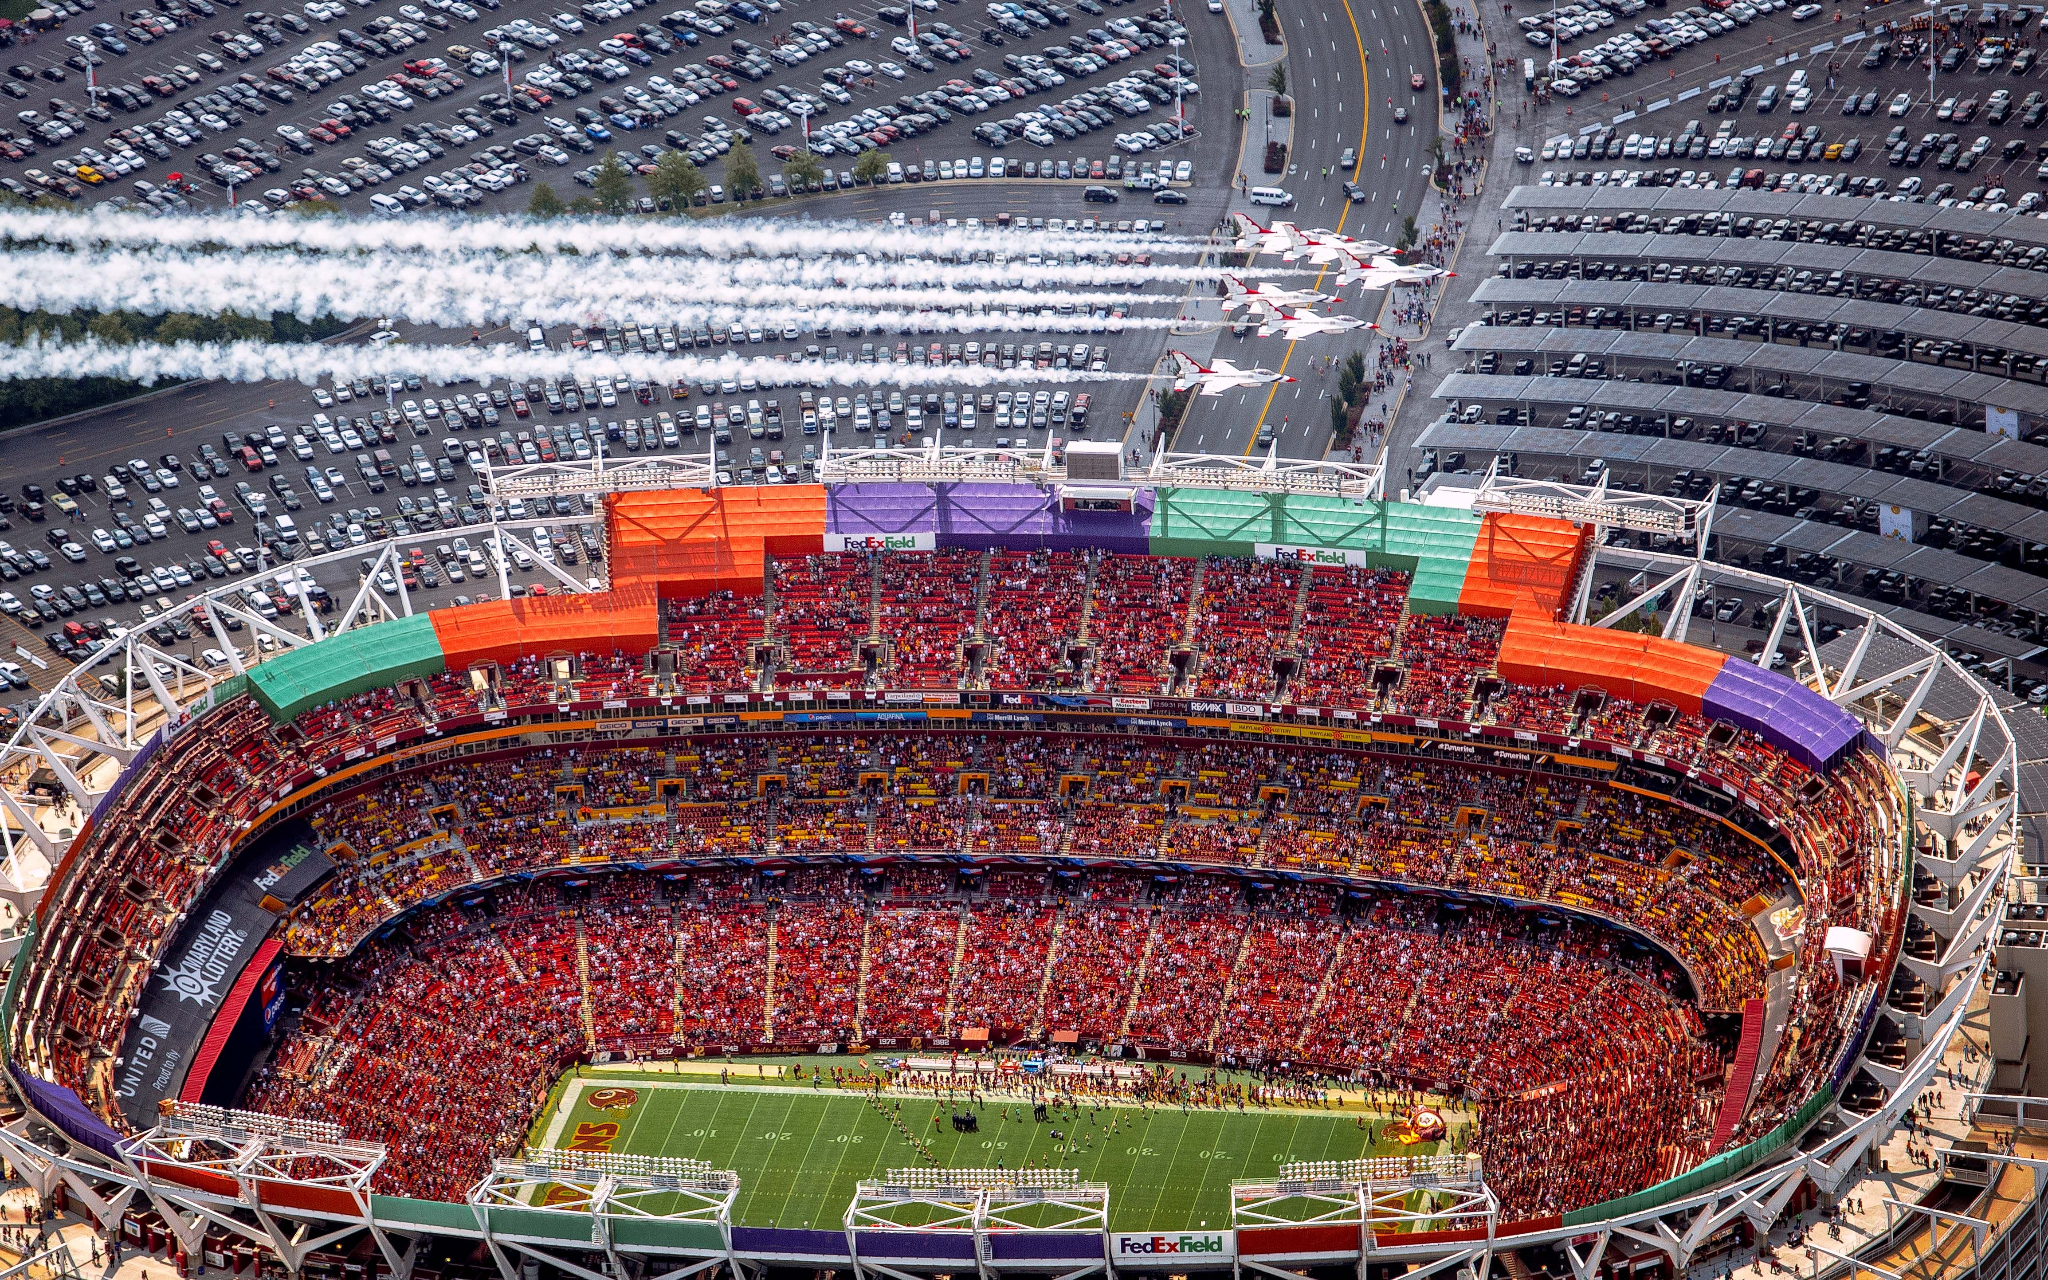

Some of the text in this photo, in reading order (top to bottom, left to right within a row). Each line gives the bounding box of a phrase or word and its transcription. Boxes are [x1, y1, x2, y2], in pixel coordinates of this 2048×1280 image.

[844, 536, 915, 550] FedExField
[1275, 547, 1346, 564] FedExField
[1002, 695, 1033, 704] FedEx
[1191, 702, 1222, 713] RE/MAX
[1235, 704, 1256, 713] BDO
[168, 696, 208, 735] FedExField
[815, 713, 832, 722] pepsi
[877, 712, 905, 720] AQUAFINA
[1013, 714, 1029, 722] Lynch
[600, 722, 627, 730] GEICO
[635, 720, 664, 728] GEICO
[671, 718, 699, 726] GEICO
[1138, 718, 1156, 726] Merrill
[1157, 719, 1173, 727] Lynch
[253, 844, 312, 892] FedExField
[181, 909, 232, 971] MARYLAND
[202, 929, 245, 982] LOTTERY
[119, 1036, 158, 1098] UNITED
[152, 1048, 181, 1092] Proud to fly
[1120, 1235, 1223, 1254] FedExField
